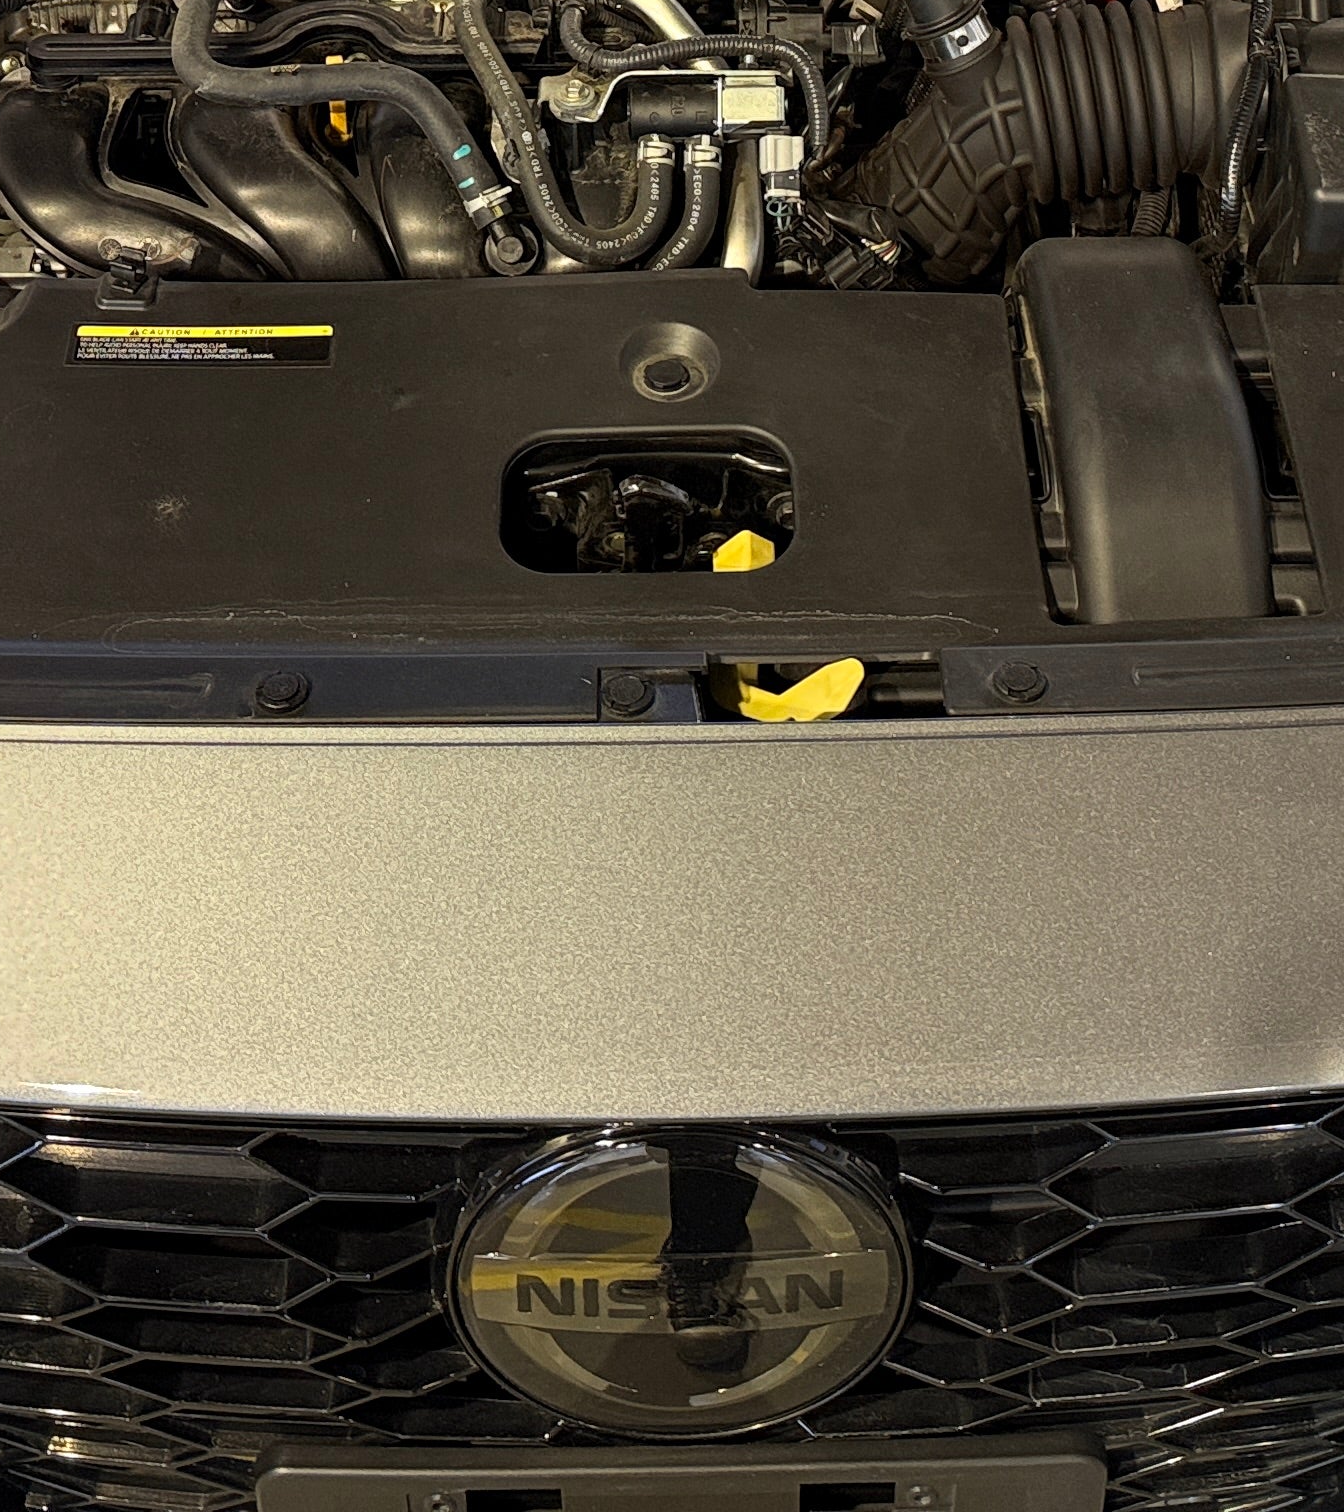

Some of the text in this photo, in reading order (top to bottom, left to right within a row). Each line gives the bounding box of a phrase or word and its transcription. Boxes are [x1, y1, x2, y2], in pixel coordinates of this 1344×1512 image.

[141, 328, 191, 336] CAUTION
[214, 328, 274, 336] ATTENTION
[516, 1269, 845, 1320] NISAN
